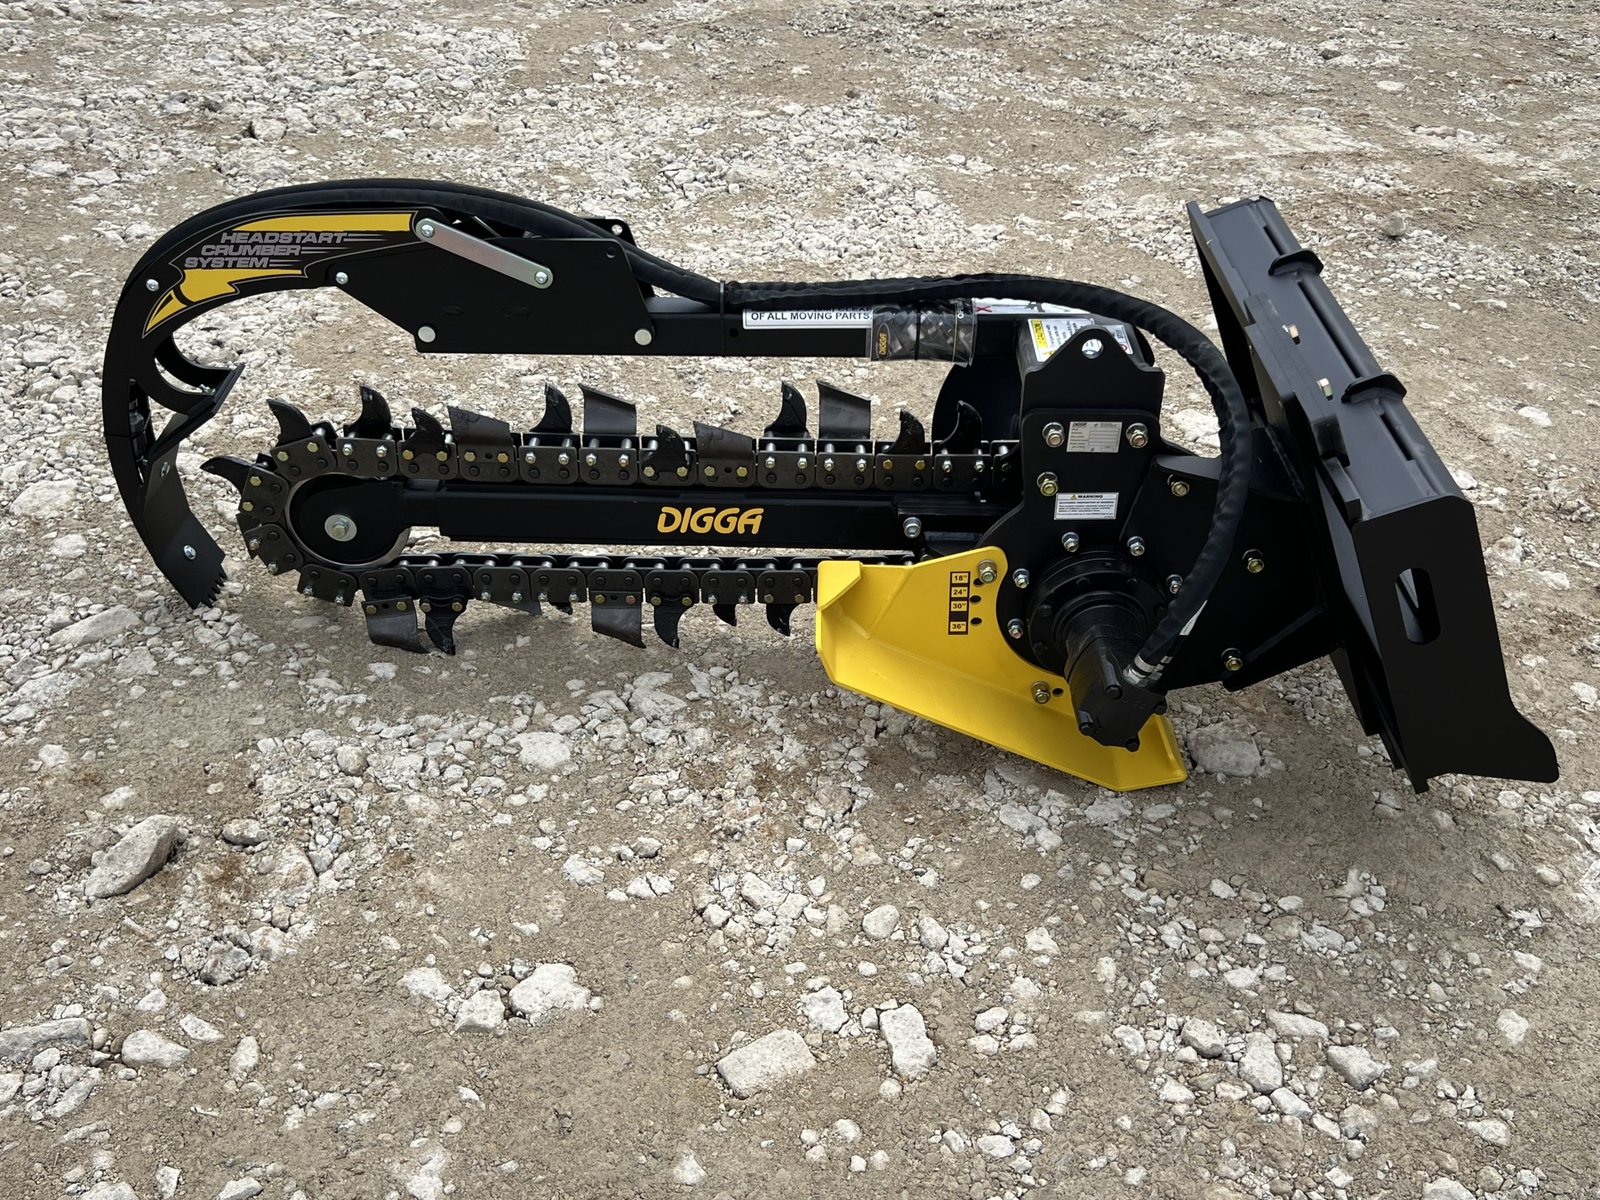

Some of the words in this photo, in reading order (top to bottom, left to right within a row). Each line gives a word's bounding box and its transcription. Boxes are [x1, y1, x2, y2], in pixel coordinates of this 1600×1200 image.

[221, 232, 349, 244] HEADSTART
[201, 244, 302, 256] CRUMBER
[184, 256, 270, 268] SYSTEM
[751, 312, 765, 321] OF
[767, 312, 788, 320] ALL
[790, 312, 833, 320] MOVING
[879, 333, 887, 355] DIGGA
[657, 506, 765, 535] DIGGA
